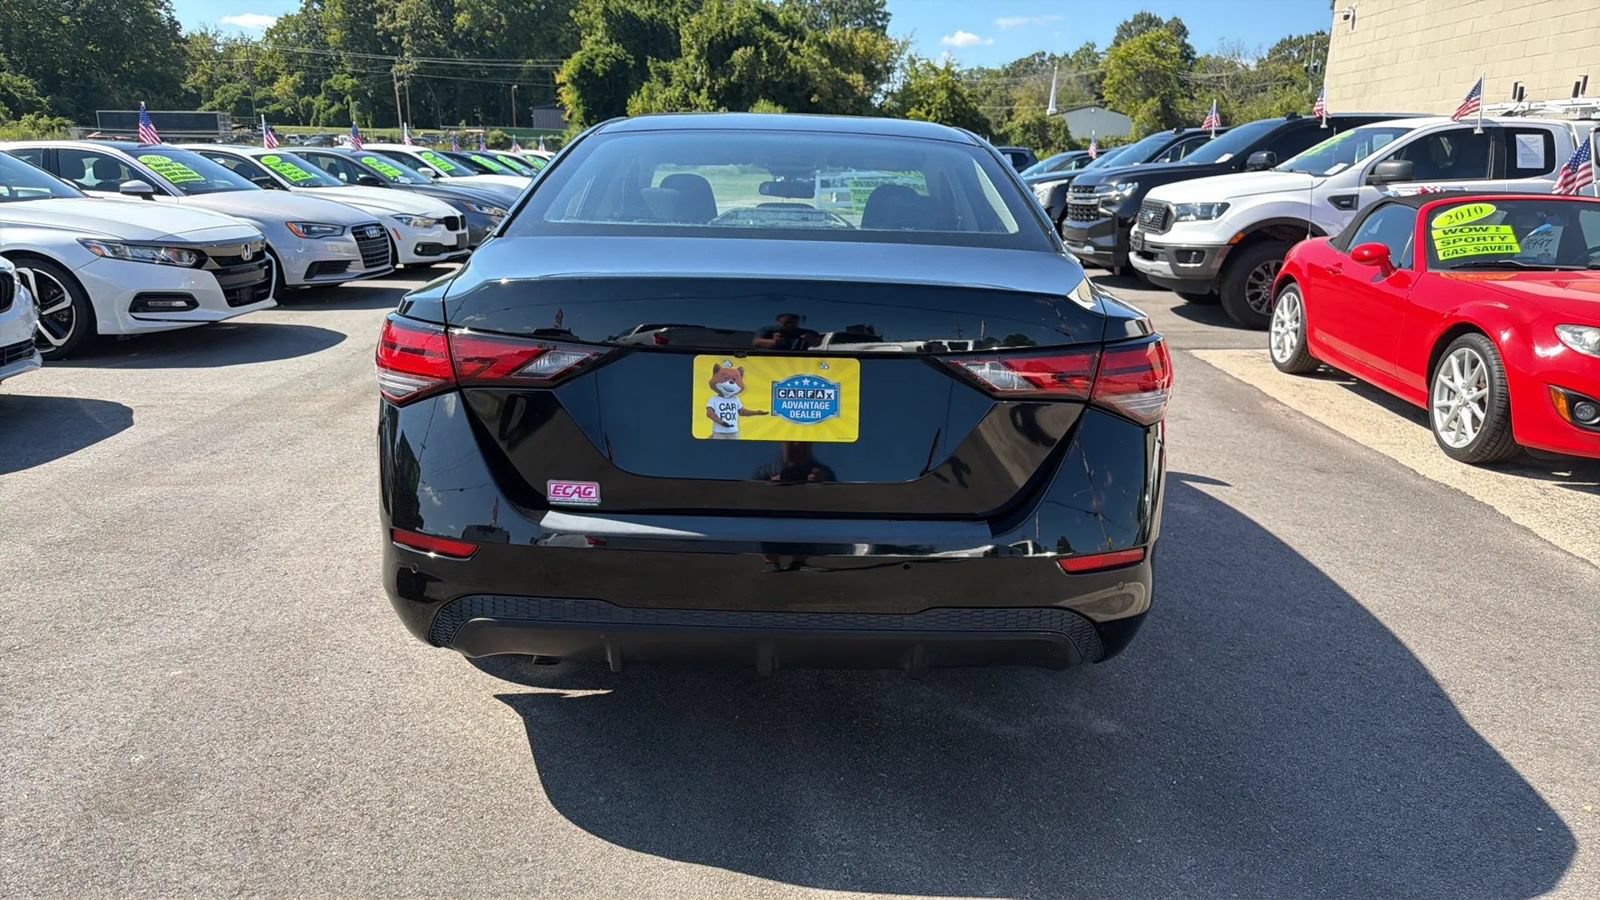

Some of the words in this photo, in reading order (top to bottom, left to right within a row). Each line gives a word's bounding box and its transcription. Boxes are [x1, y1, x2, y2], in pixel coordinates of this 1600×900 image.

[1446, 205, 1483, 224] 2010
[1441, 236, 1507, 247] SPORTY
[1442, 245, 1513, 257] GAS-SAVER
[778, 389, 834, 400] CARFAX
[718, 402, 737, 412] CAR
[781, 401, 830, 410] ADVANTAGE
[720, 412, 737, 421] FOX
[789, 410, 822, 419] DEALER
[552, 485, 594, 498] ECAG
